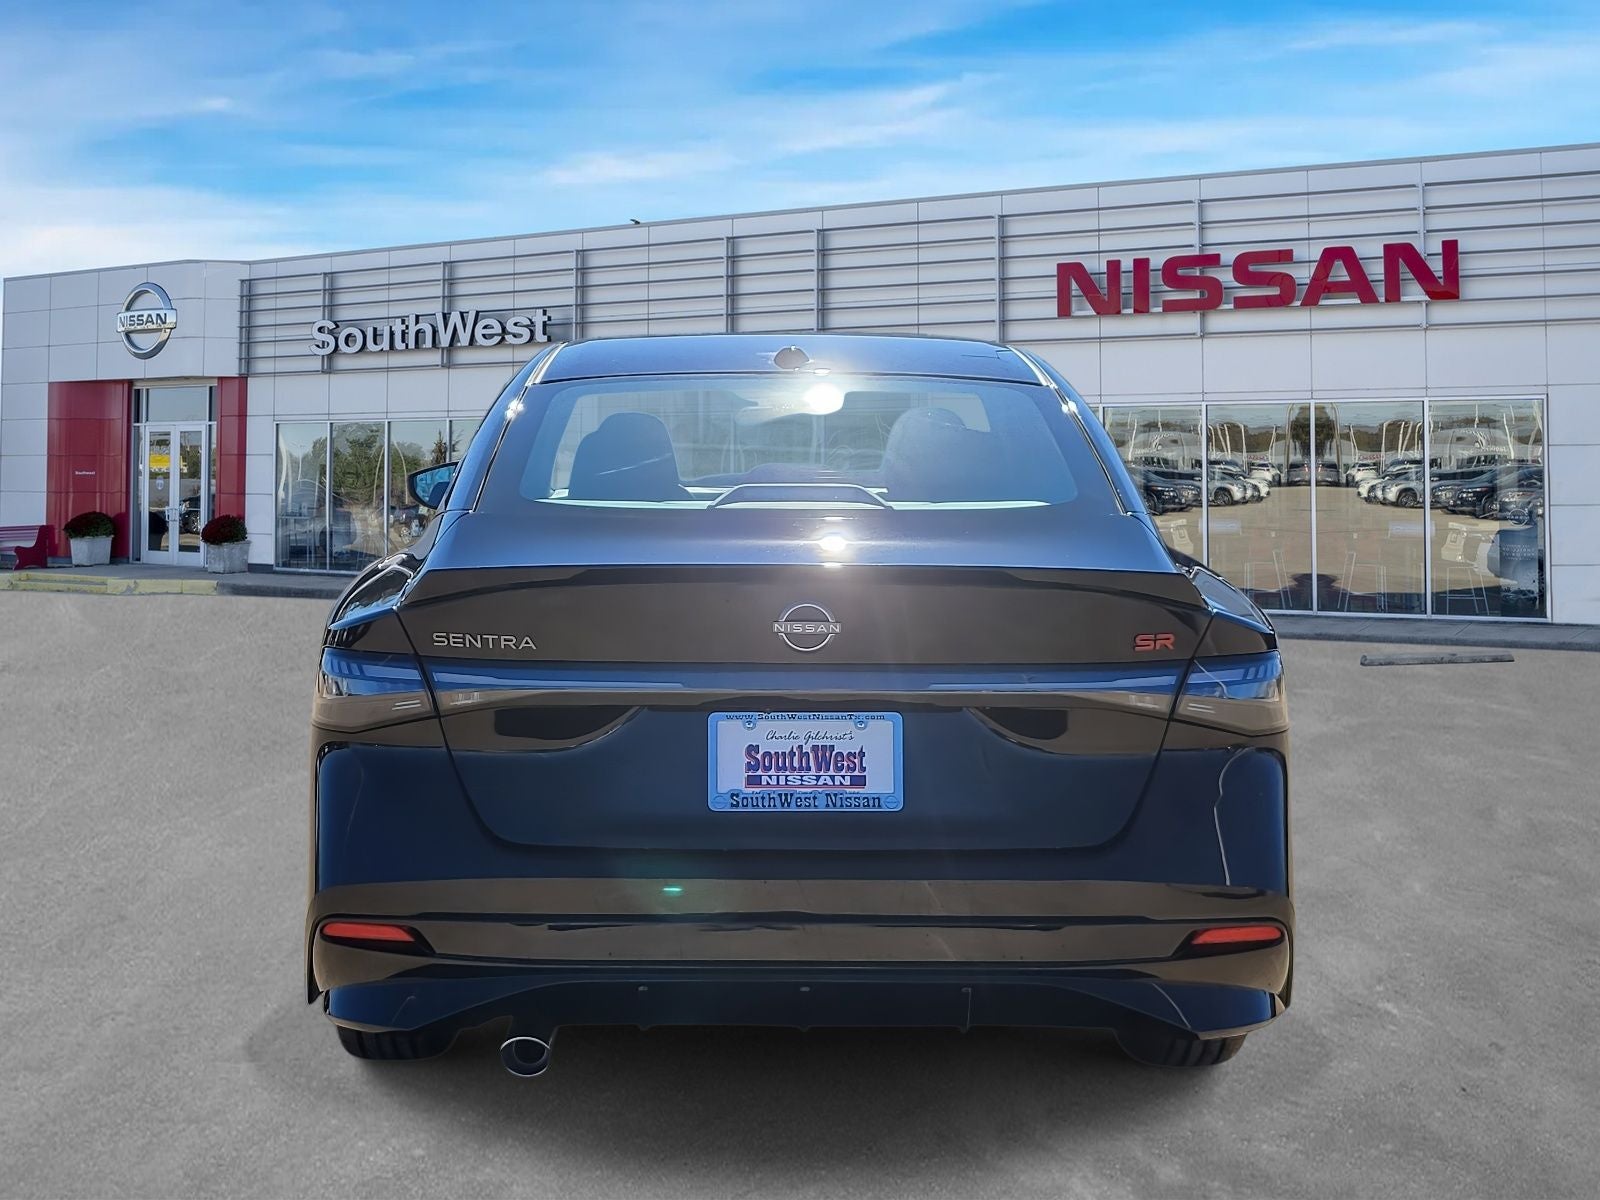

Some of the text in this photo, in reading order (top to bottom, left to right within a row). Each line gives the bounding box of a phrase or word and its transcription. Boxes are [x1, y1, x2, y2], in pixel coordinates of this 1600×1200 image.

[1056, 239, 1461, 318] NISSAN
[119, 313, 167, 328] NISSAN
[309, 308, 551, 356] SouthWest
[774, 623, 840, 633] NISSAN
[432, 632, 537, 650] SENTRA
[1134, 633, 1175, 651] SR
[765, 729, 855, 746] Charlie Gilchrist's
[744, 743, 867, 774] SouthWest
[760, 775, 851, 787] NISSAN
[729, 792, 883, 809] SouthWest Nissan
